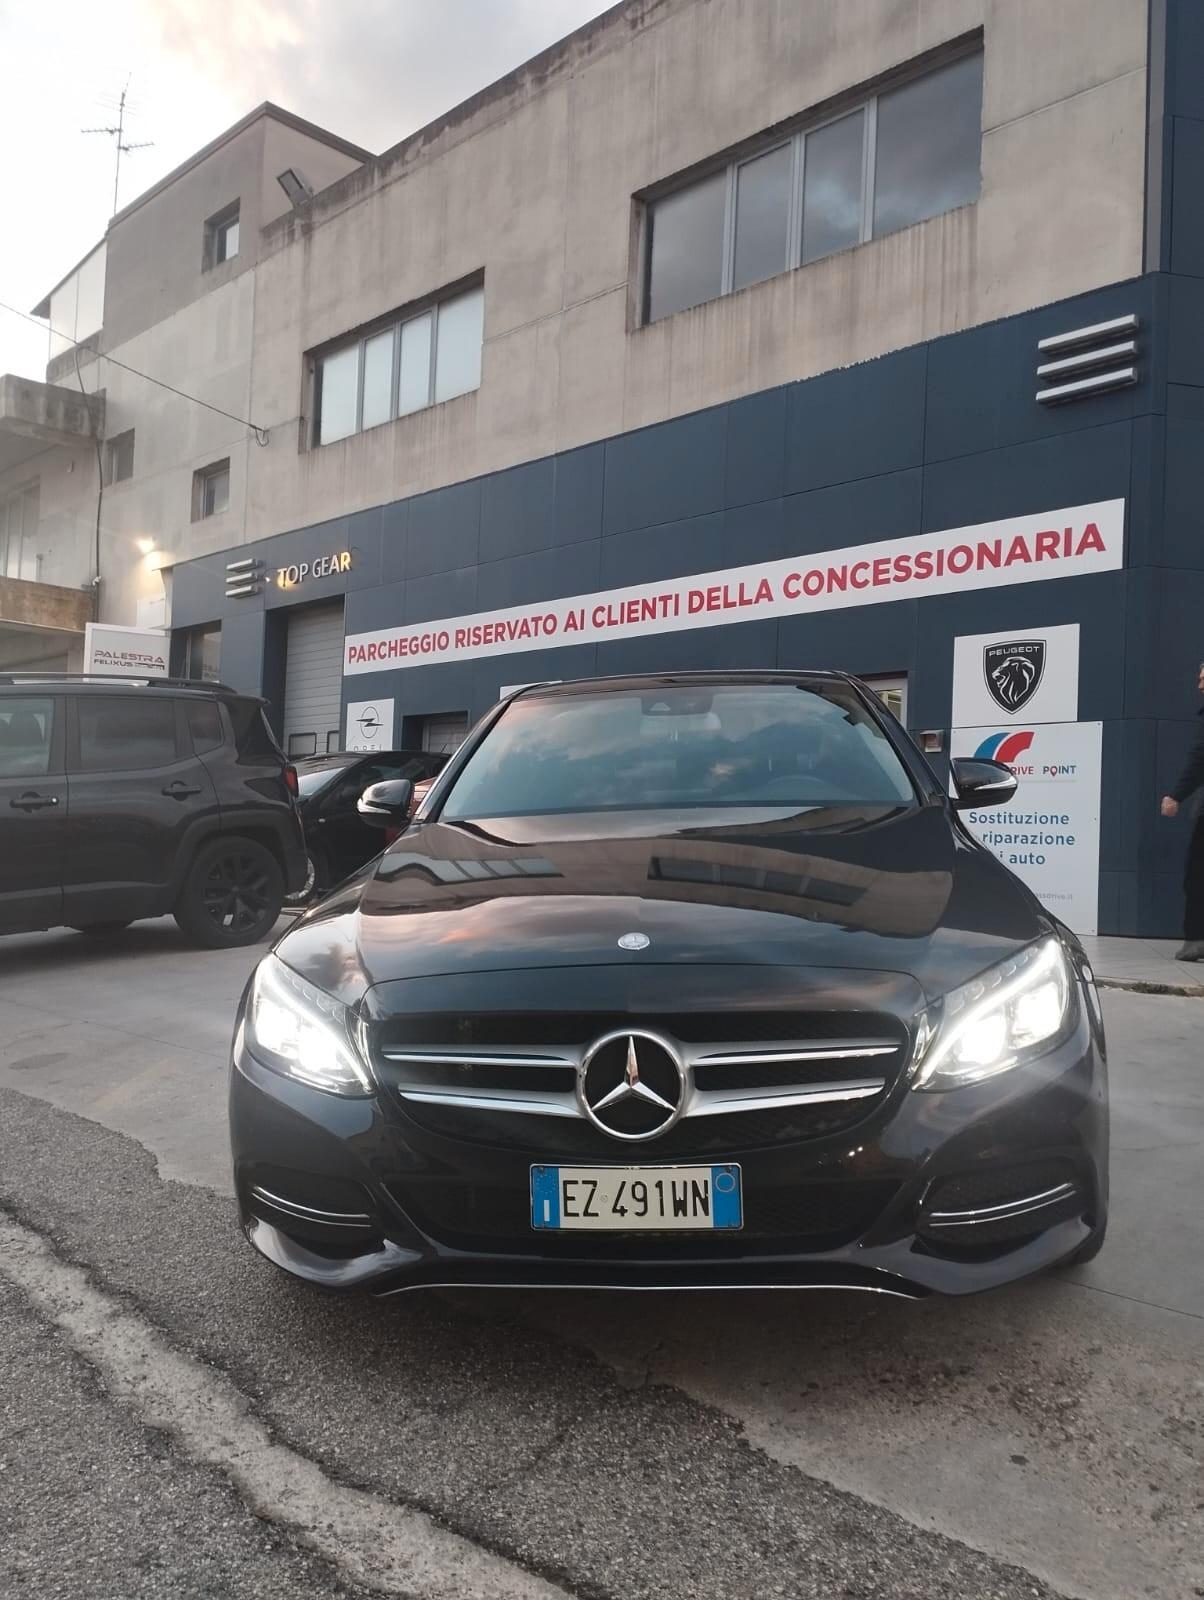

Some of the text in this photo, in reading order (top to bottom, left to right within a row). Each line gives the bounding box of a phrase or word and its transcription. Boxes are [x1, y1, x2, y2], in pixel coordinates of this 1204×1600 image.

[277, 552, 351, 587] TOP GEAR
[348, 522, 1106, 664] PARCHEGGIO RISERVATO AI CLIENTI DELLA CONCESSIONARIA
[94, 649, 165, 664] PALESTRA
[989, 646, 1040, 657] PEUGEOT
[93, 658, 134, 668] FELIXUS
[1010, 765, 1077, 777] RIVE POINT
[969, 811, 1070, 825] Sostituzione
[982, 831, 1075, 846] riparazione
[1009, 852, 1046, 865] auto
[562, 1180, 599, 1217] EZ
[611, 1180, 710, 1217] 491WN
